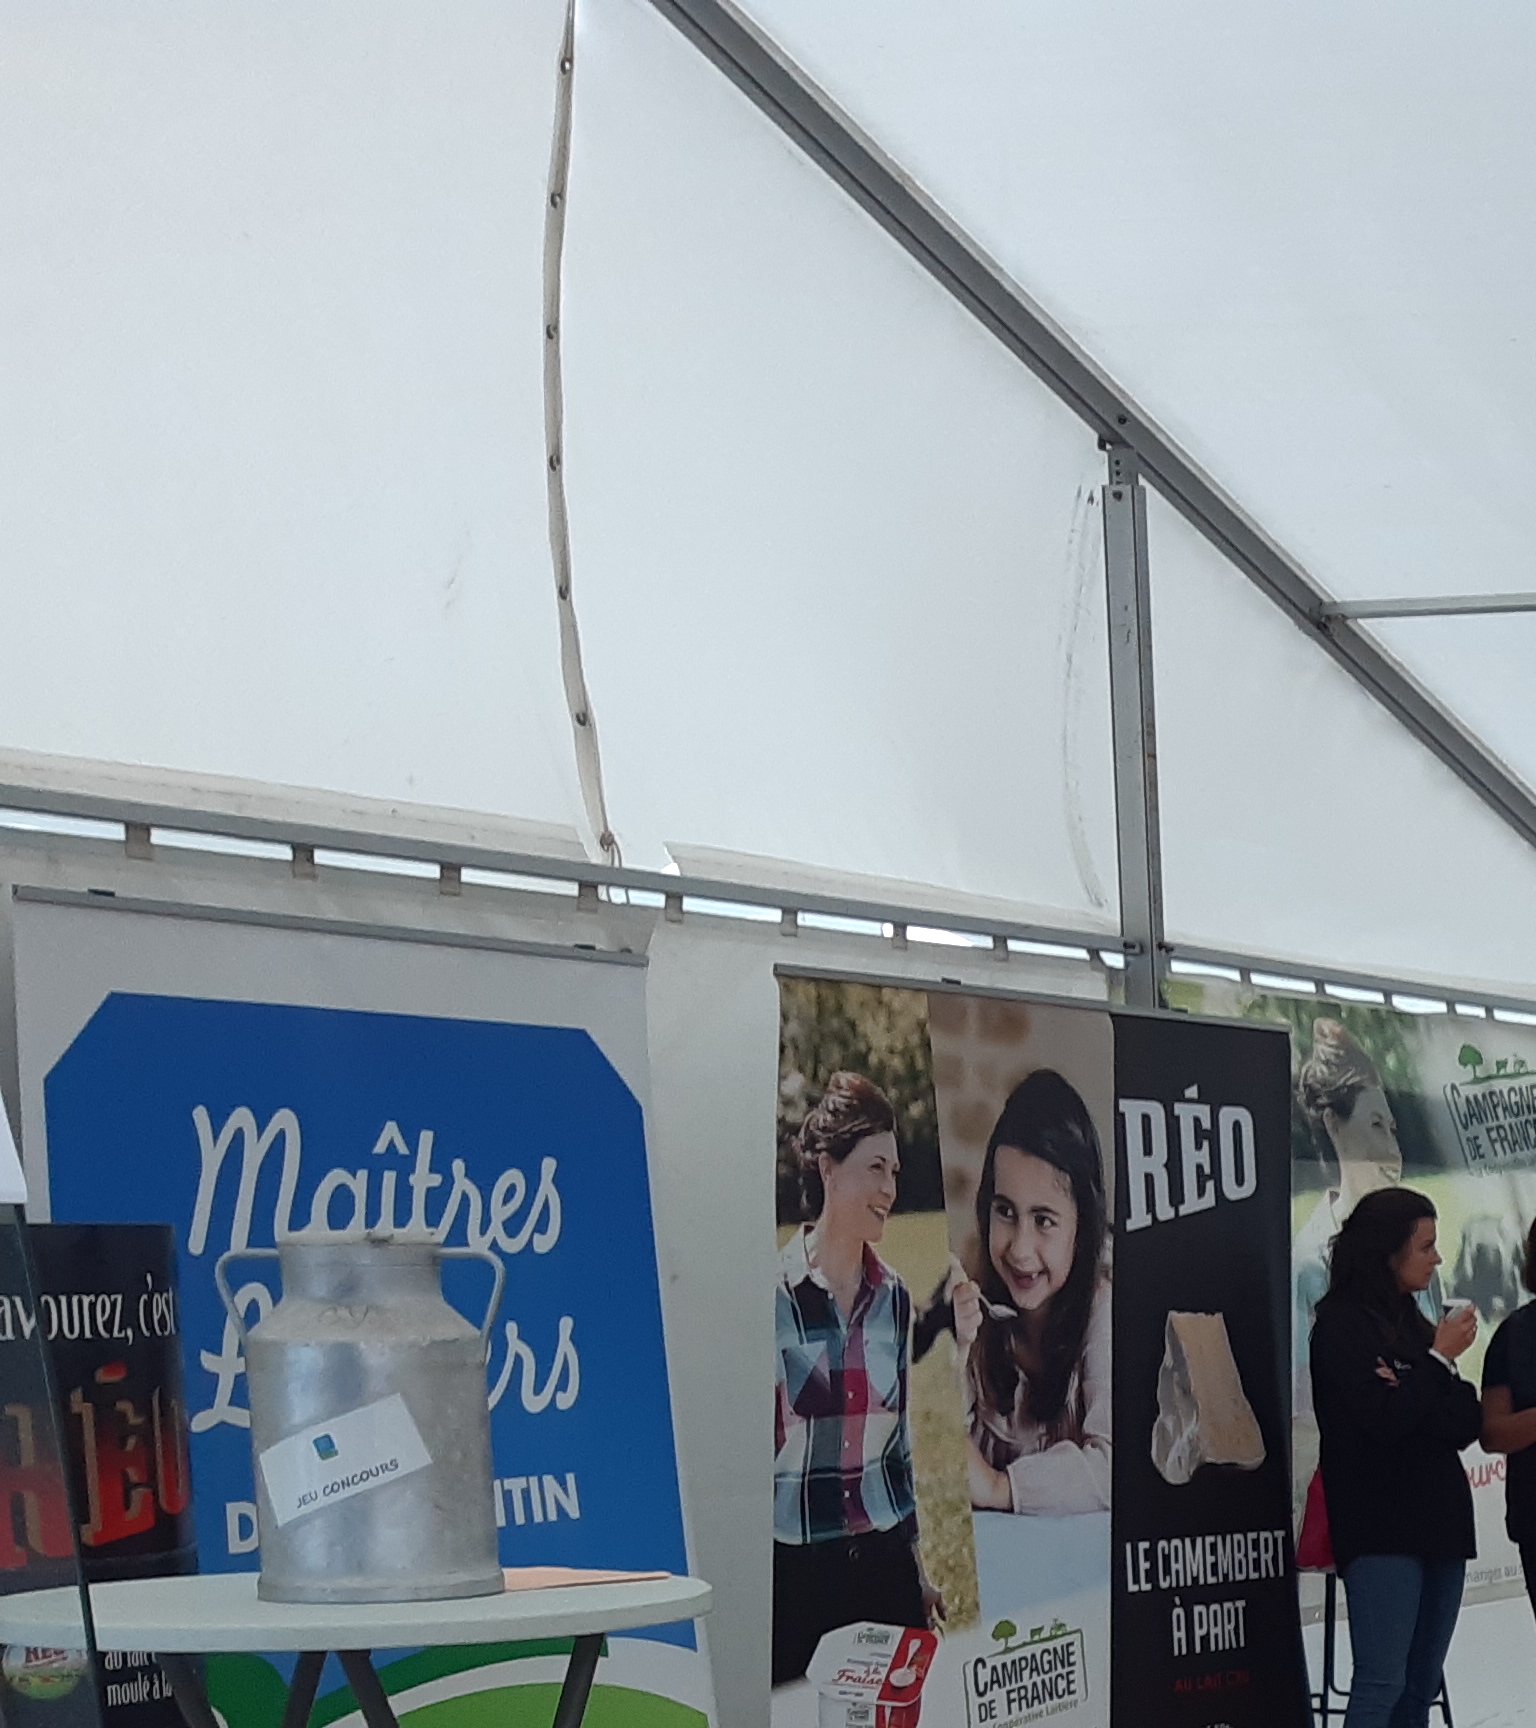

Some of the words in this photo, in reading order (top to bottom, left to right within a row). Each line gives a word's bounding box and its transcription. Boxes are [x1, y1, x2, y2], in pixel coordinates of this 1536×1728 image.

[1119, 1084, 1257, 1232] RÉO
[1466, 1135, 1486, 1160] DE
[187, 1104, 562, 1256] Maîtres
[296, 1490, 318, 1509] JEU
[322, 1458, 400, 1498] CONCOURS
[1126, 1540, 1152, 1592] LE
[1157, 1530, 1286, 1590] CAMEMBERT
[1172, 1595, 1187, 1656] À
[1193, 1600, 1246, 1654] PART
[106, 1672, 150, 1708] moulé
[973, 1641, 1077, 1698] CAMPAGNE
[978, 1699, 998, 1723] DE
[1006, 1670, 1077, 1715] FRANCE
